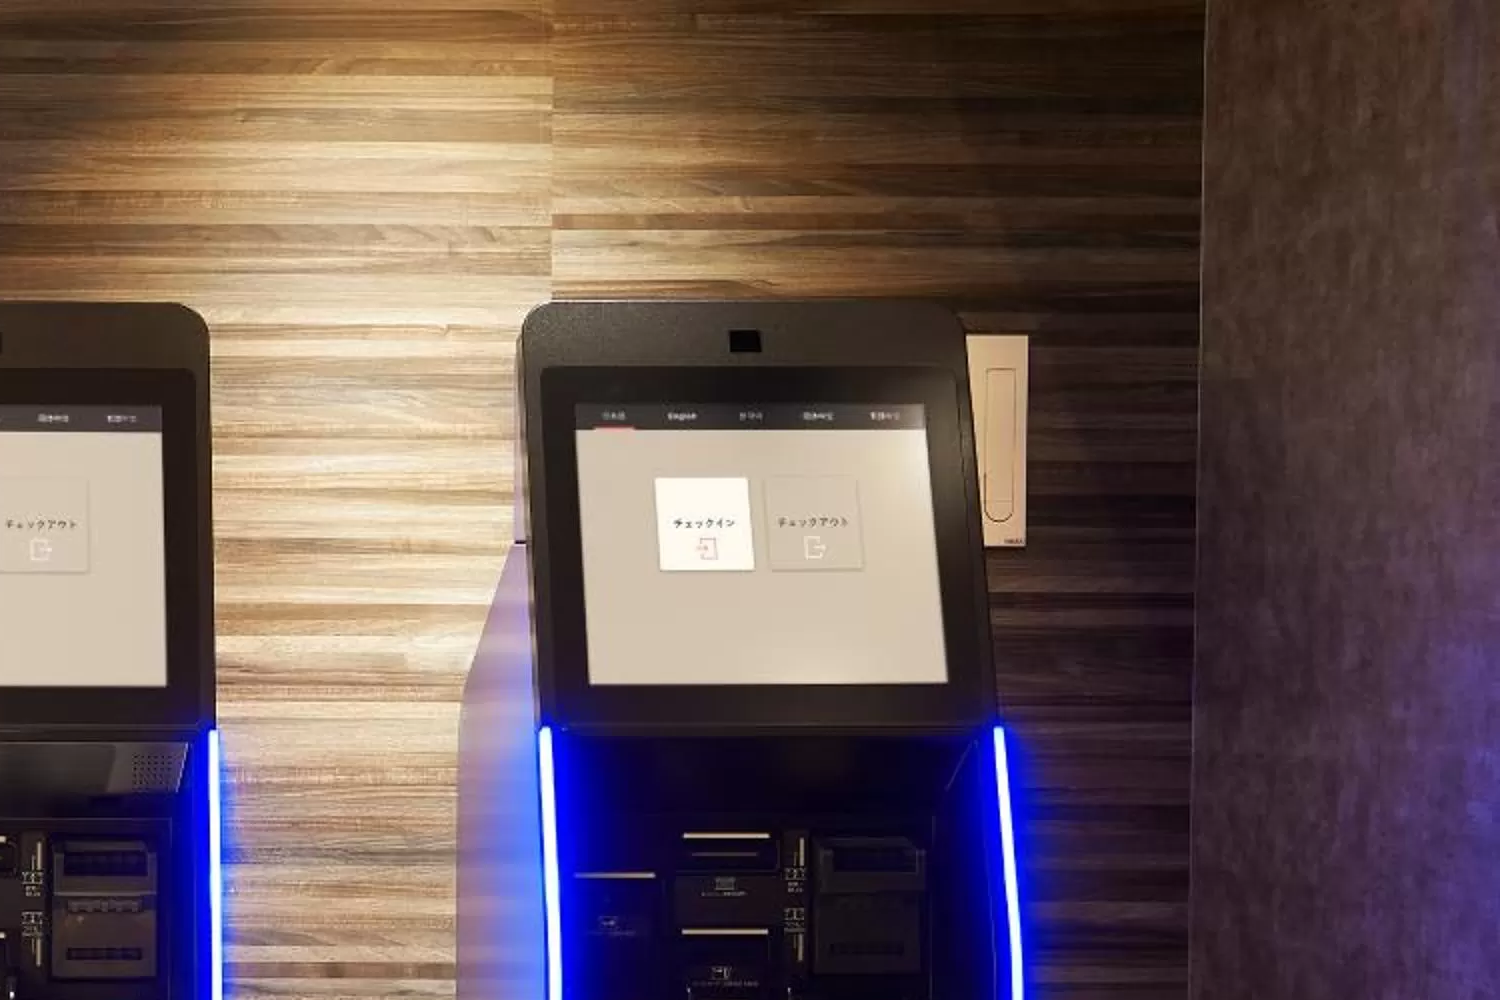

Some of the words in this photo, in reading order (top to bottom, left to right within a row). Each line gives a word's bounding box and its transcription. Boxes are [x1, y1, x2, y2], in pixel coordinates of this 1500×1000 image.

[5, 519, 77, 531] チェックアウト
[673, 517, 735, 529] チェックイン
